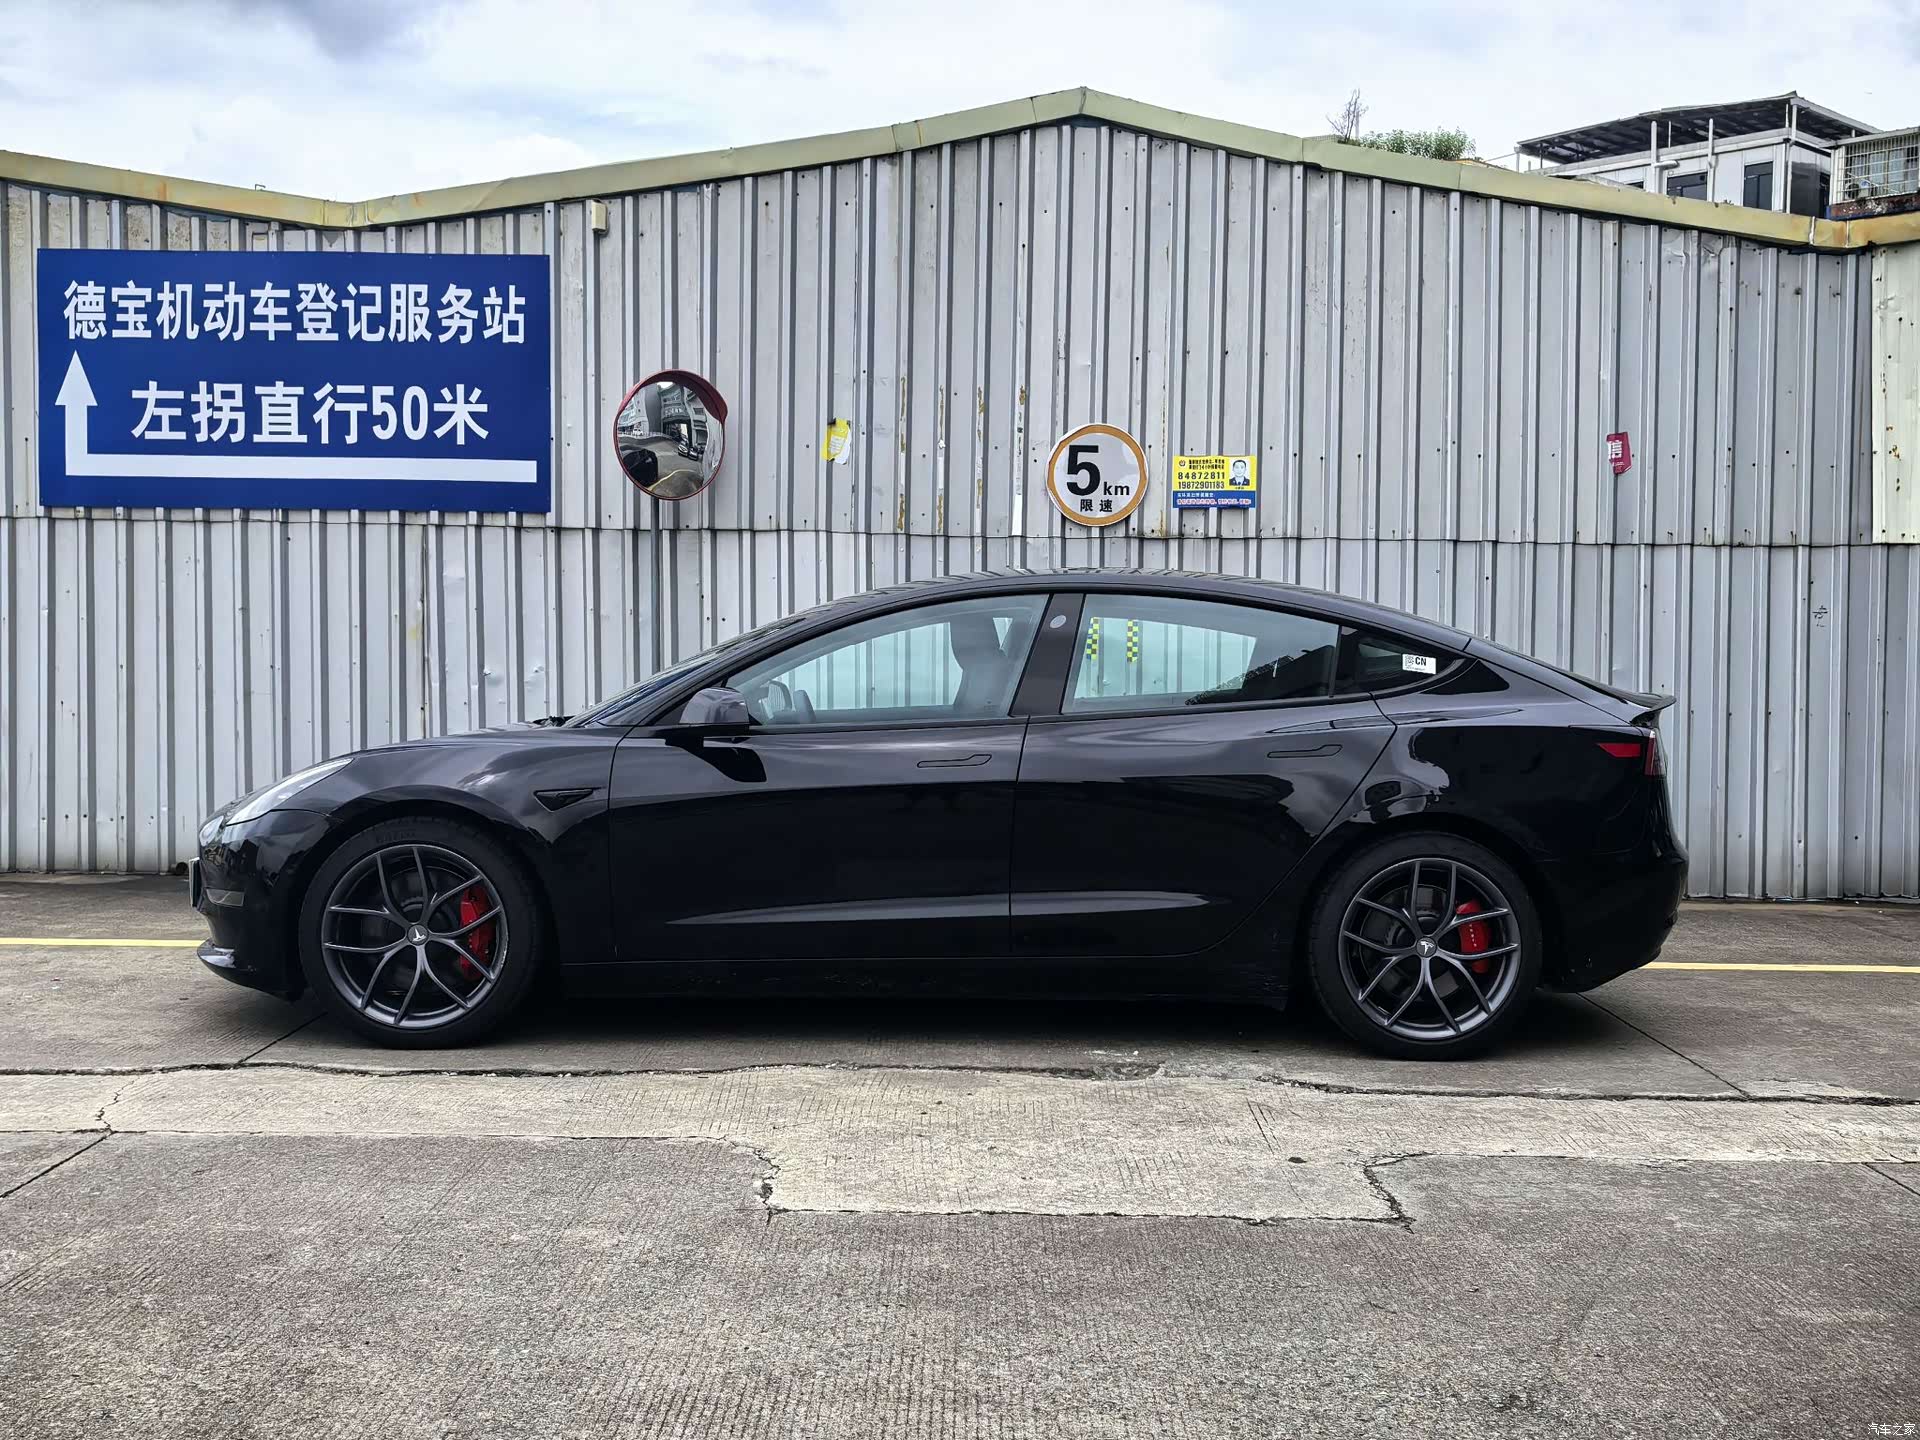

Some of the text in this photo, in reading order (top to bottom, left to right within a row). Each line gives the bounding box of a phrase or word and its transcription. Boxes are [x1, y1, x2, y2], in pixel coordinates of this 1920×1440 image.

[64, 280, 526, 344] 德宝机动车登记服务站
[131, 380, 489, 446] 左拐直行50米
[1178, 471, 1225, 480] 84872811
[1080, 498, 1113, 513] 限速
[1415, 656, 1427, 667] CN
